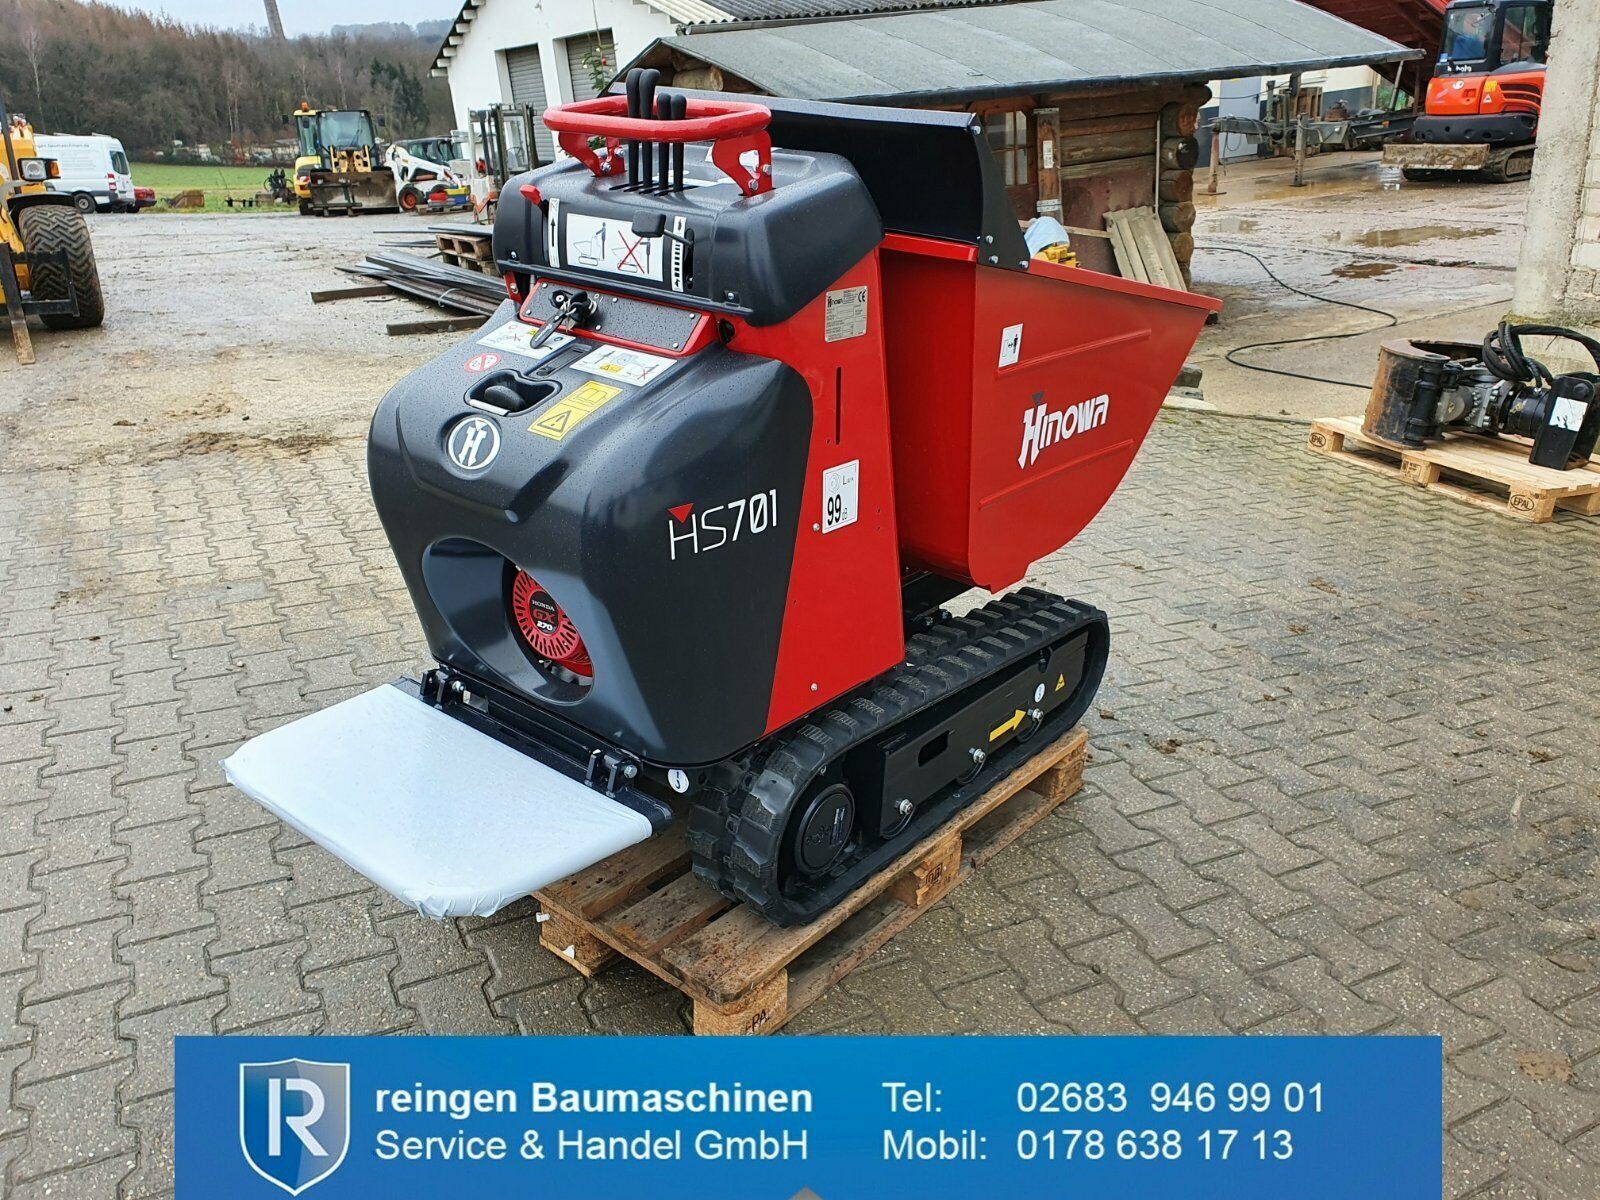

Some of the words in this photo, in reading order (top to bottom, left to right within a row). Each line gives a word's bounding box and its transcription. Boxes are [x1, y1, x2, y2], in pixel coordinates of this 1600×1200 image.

[827, 494, 842, 526] 99
[668, 488, 777, 561] HS701
[532, 599, 555, 612] HONDA
[533, 609, 555, 625] GX
[536, 620, 553, 631] 270
